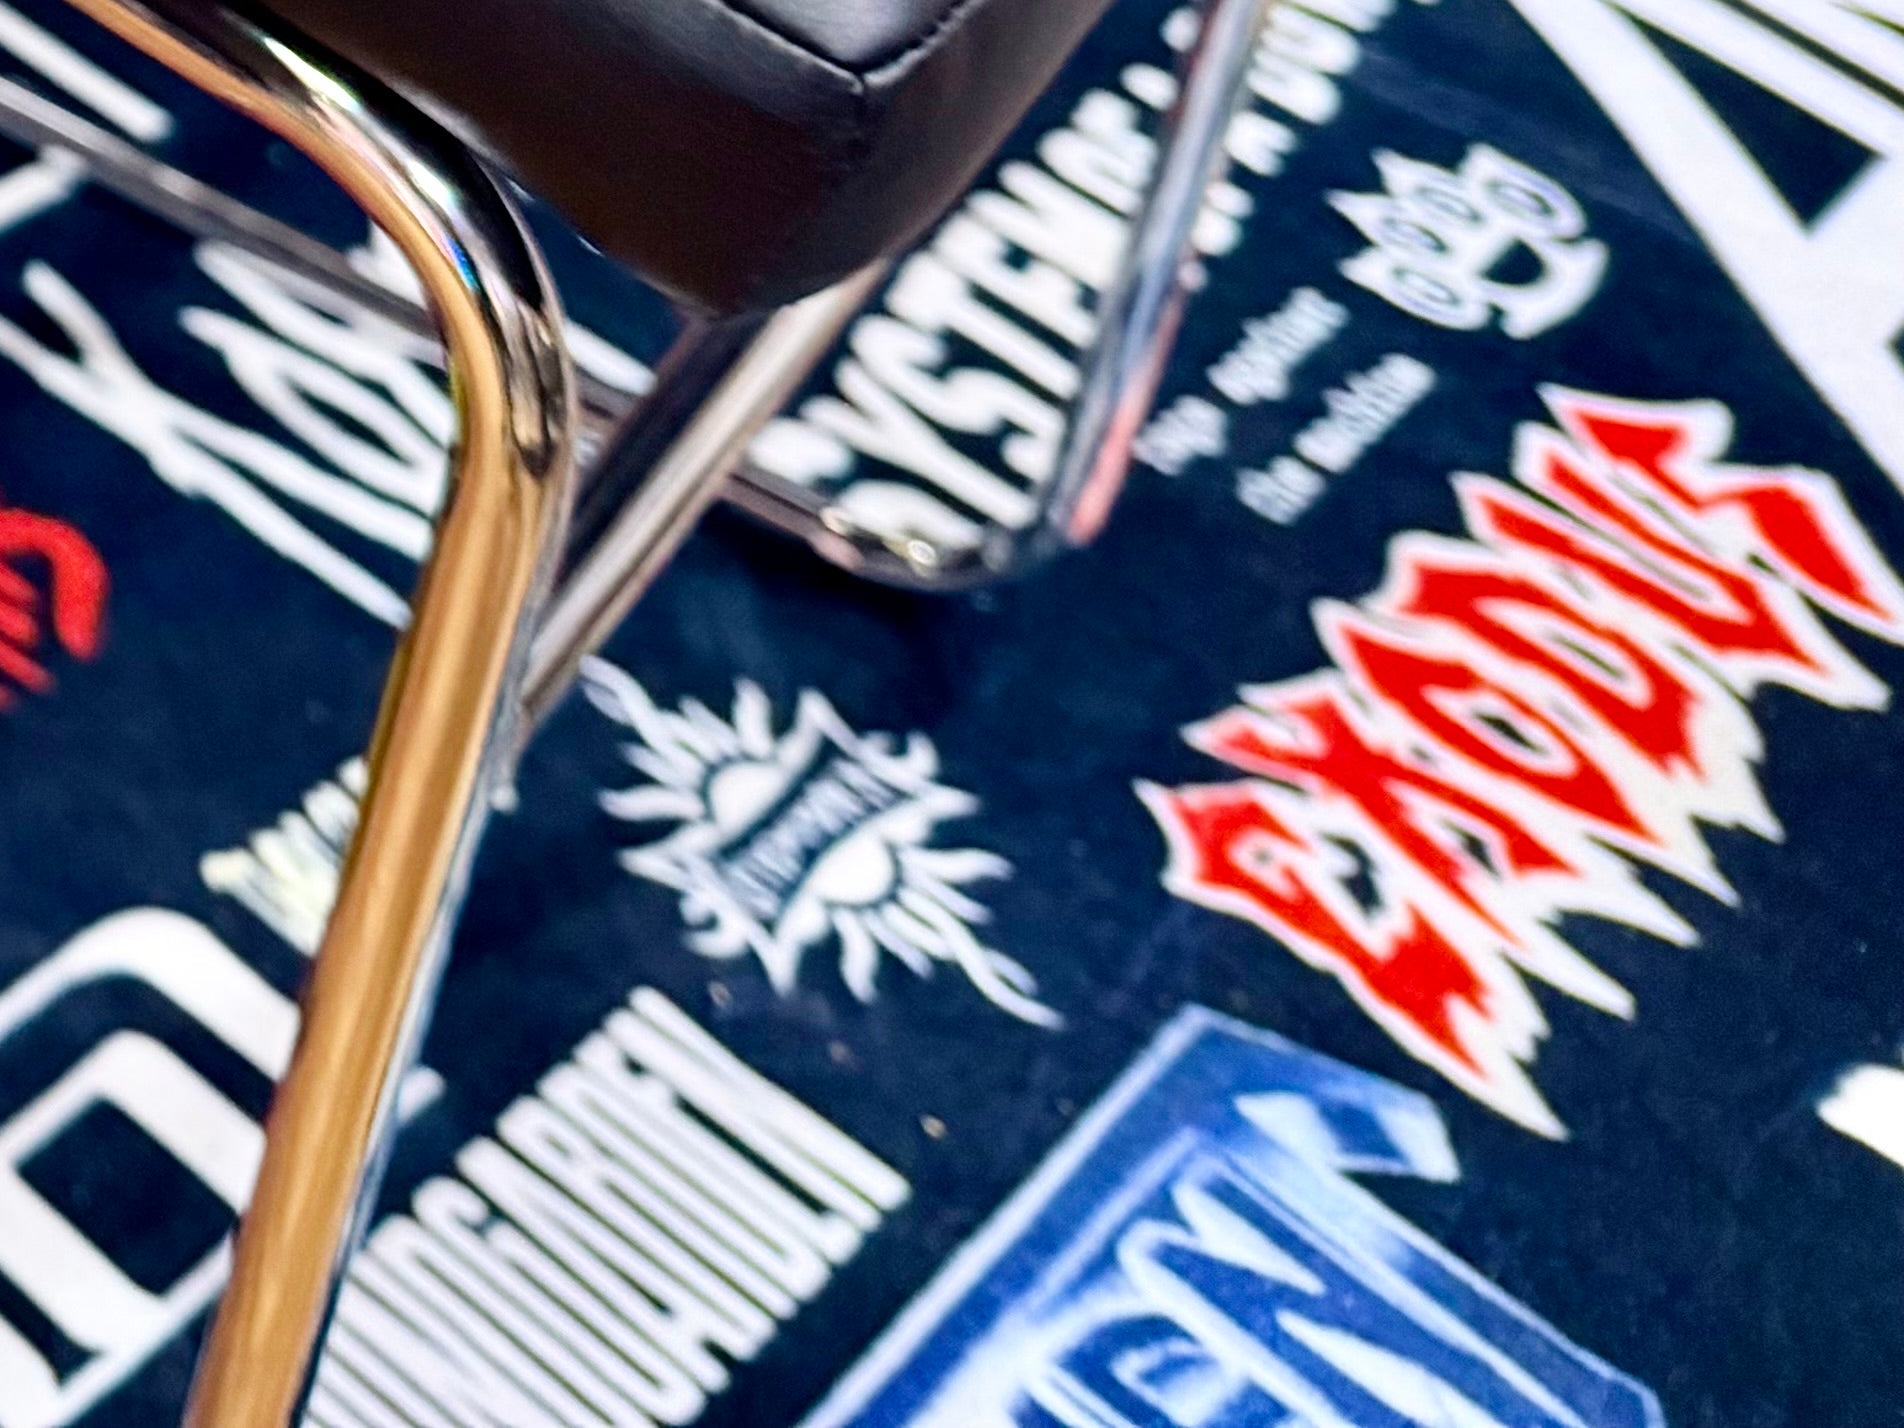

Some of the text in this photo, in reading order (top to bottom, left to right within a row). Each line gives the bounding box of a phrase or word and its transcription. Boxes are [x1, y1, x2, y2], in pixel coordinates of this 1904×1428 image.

[1205, 285, 1350, 406] against
[1236, 455, 1326, 527] the
[1130, 382, 1904, 1142] EXODUS
